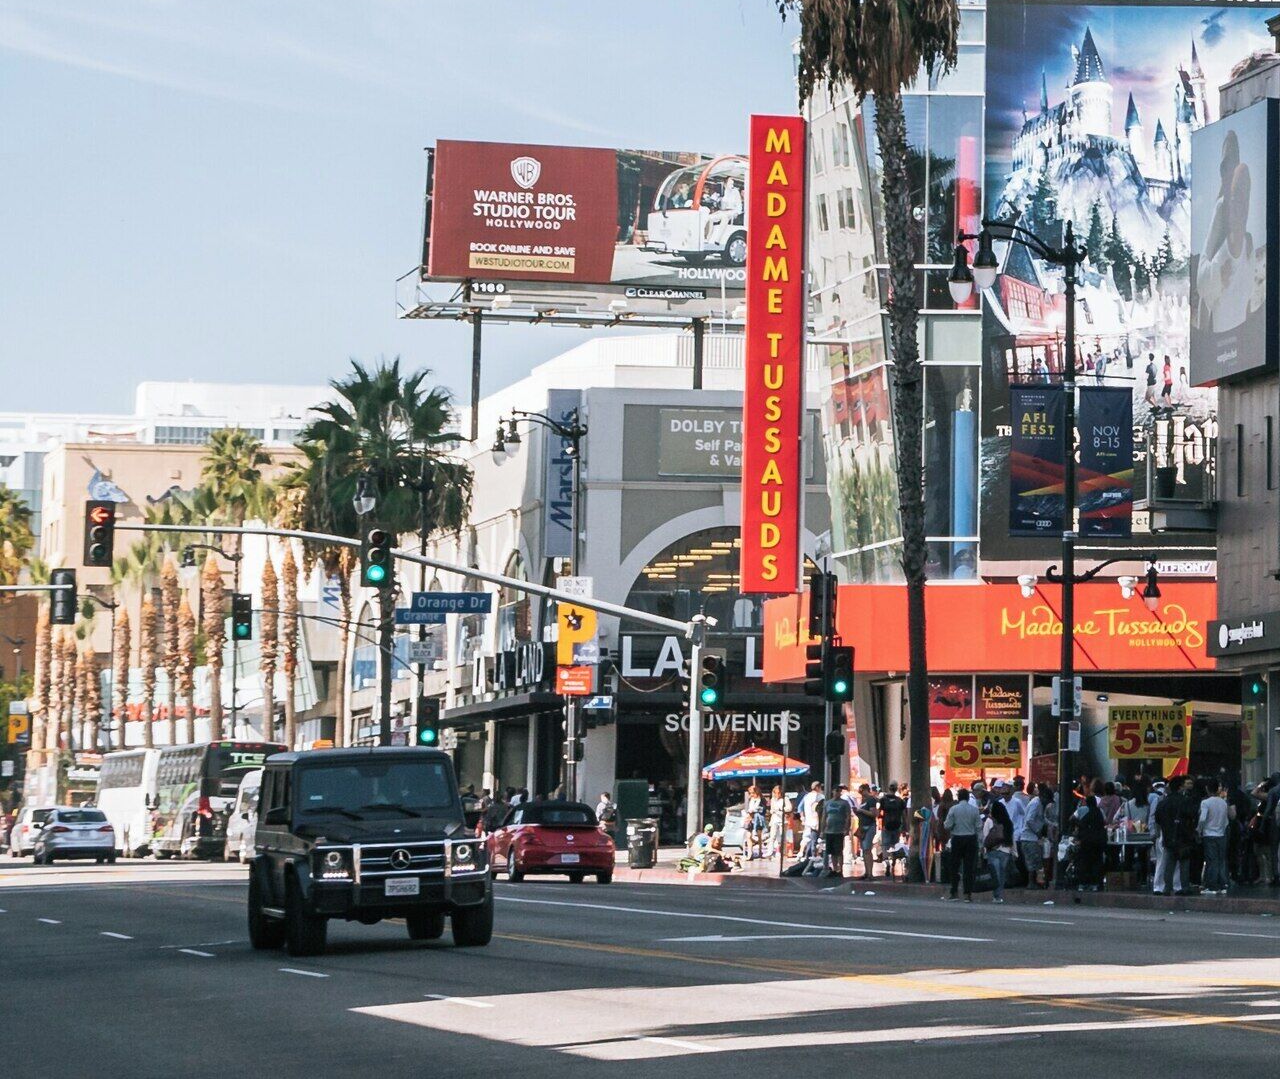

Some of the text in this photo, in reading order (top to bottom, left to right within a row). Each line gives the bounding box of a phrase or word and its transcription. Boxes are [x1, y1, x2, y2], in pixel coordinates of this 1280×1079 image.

[474, 189, 577, 207] WARNER BROS.
[473, 203, 577, 221] STUDIO TOUR
[486, 218, 562, 231] HOLLYWOOD
[470, 242, 576, 256] BOOK ONLINE AND SAVE
[474, 256, 571, 270] WBSTUDIOTOUR.COM
[760, 127, 792, 581] MADAME TUSSAUDS
[1022, 412, 1047, 423] AFI
[670, 420, 725, 433] DOLBY
[996, 425, 1013, 437] TH
[1022, 424, 1056, 436] FEST
[1093, 426, 1120, 436] NOV
[695, 440, 720, 451] Self
[709, 455, 720, 466] &
[418, 597, 486, 611] Orange Dr
[1094, 604, 1204, 648] Tussauds
[1129, 638, 1182, 647] HOLLYWOOD
[622, 636, 687, 677] LA
[515, 641, 544, 687] LAND
[982, 686, 1023, 700] Madame
[983, 698, 1022, 711] Tussauds
[1112, 710, 1183, 721] EVERYTHING'S
[953, 723, 1019, 734] EVERYTHING'S
